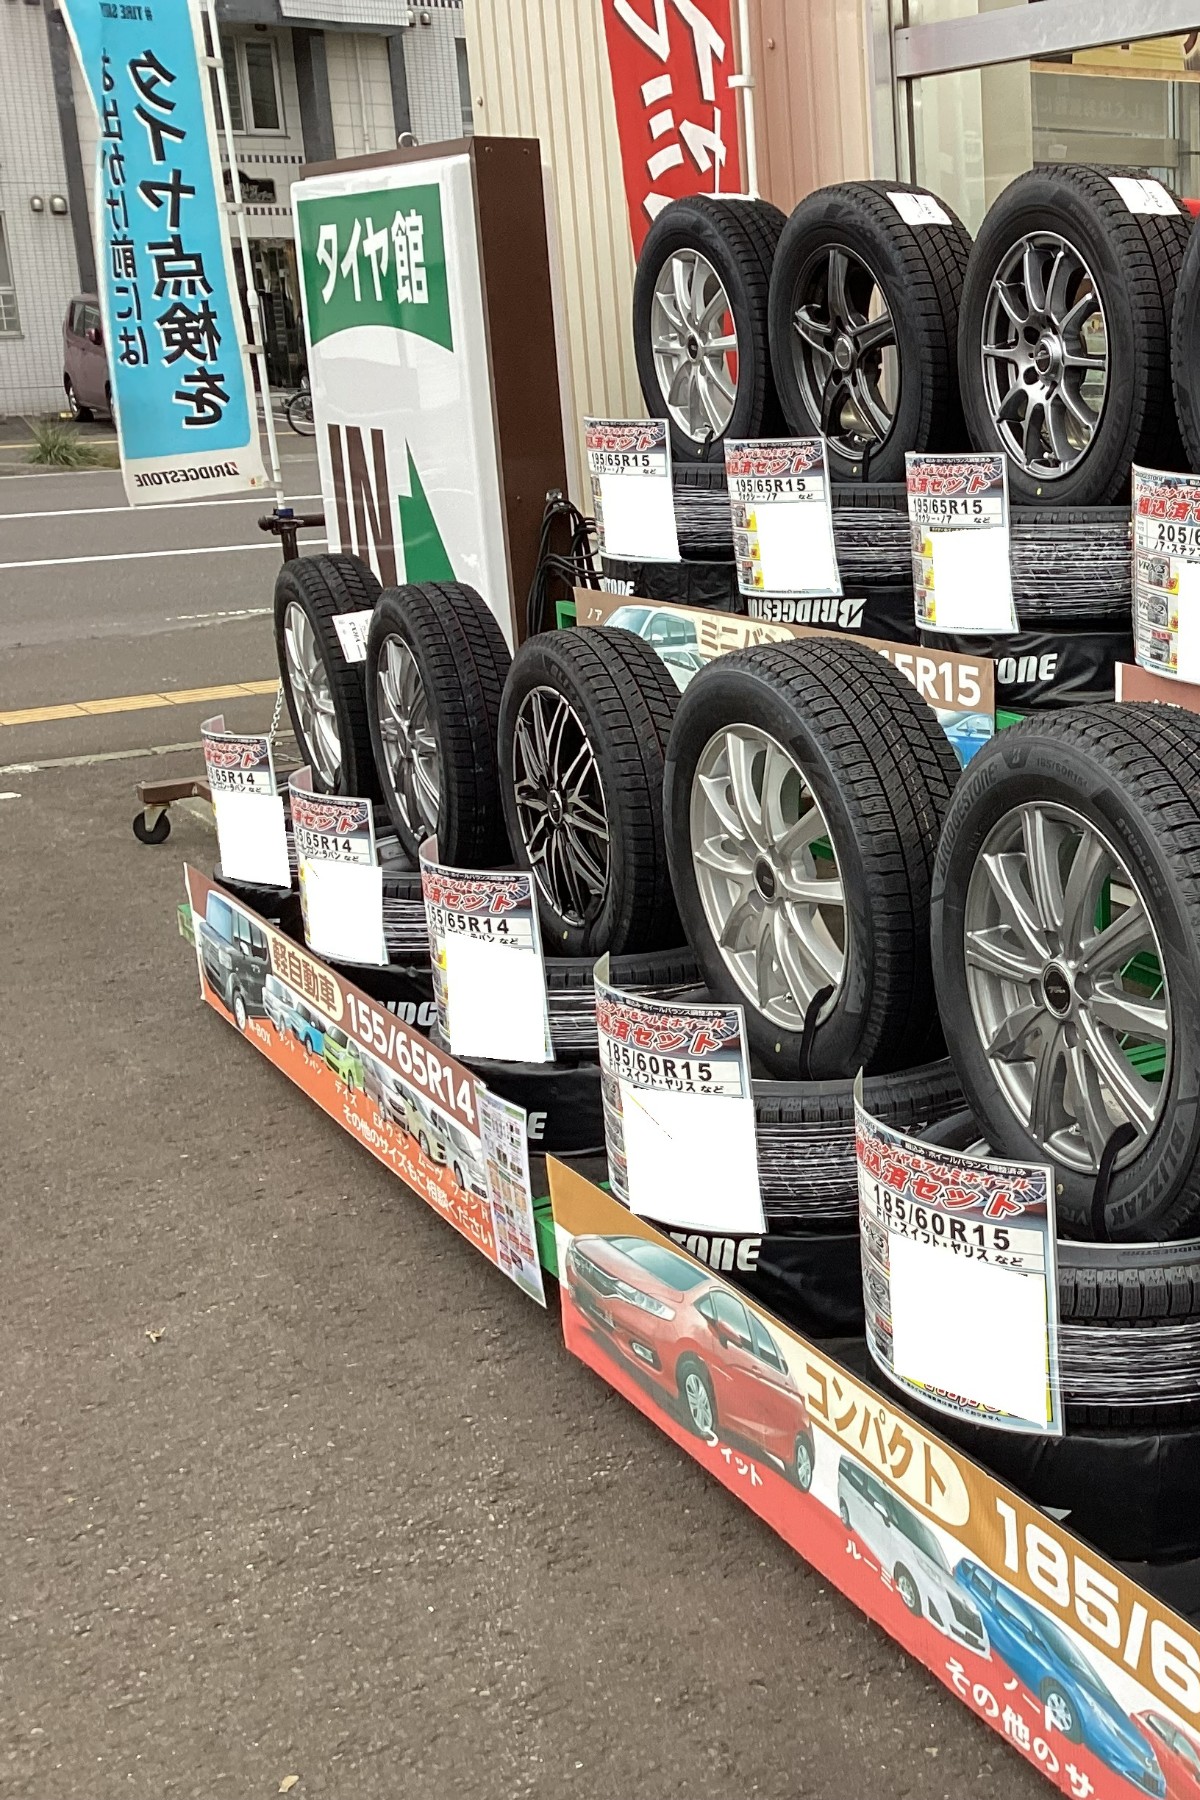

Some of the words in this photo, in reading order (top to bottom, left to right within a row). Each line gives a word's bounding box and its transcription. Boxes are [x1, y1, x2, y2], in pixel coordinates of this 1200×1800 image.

[315, 208, 430, 305] タイヤ館
[591, 453, 650, 467] 195/65R15
[735, 478, 806, 492] 195/65R15
[326, 423, 399, 588] IN
[913, 498, 983, 515] 195/65R15
[271, 936, 337, 1012] 軽自動車
[346, 992, 476, 1125] 155/65R14
[605, 1039, 713, 1082] 185/60R15
[701, 1083, 724, 1095] など
[334, 1079, 358, 1107] デイズ
[341, 1103, 494, 1250] その他のサイズもご相談ください
[872, 1183, 1010, 1251] 185/60R15
[995, 1253, 1024, 1268] など
[805, 1360, 947, 1508] コンパクト
[844, 1539, 912, 1604] ルーミー
[1002, 1673, 1067, 1732] ノート
